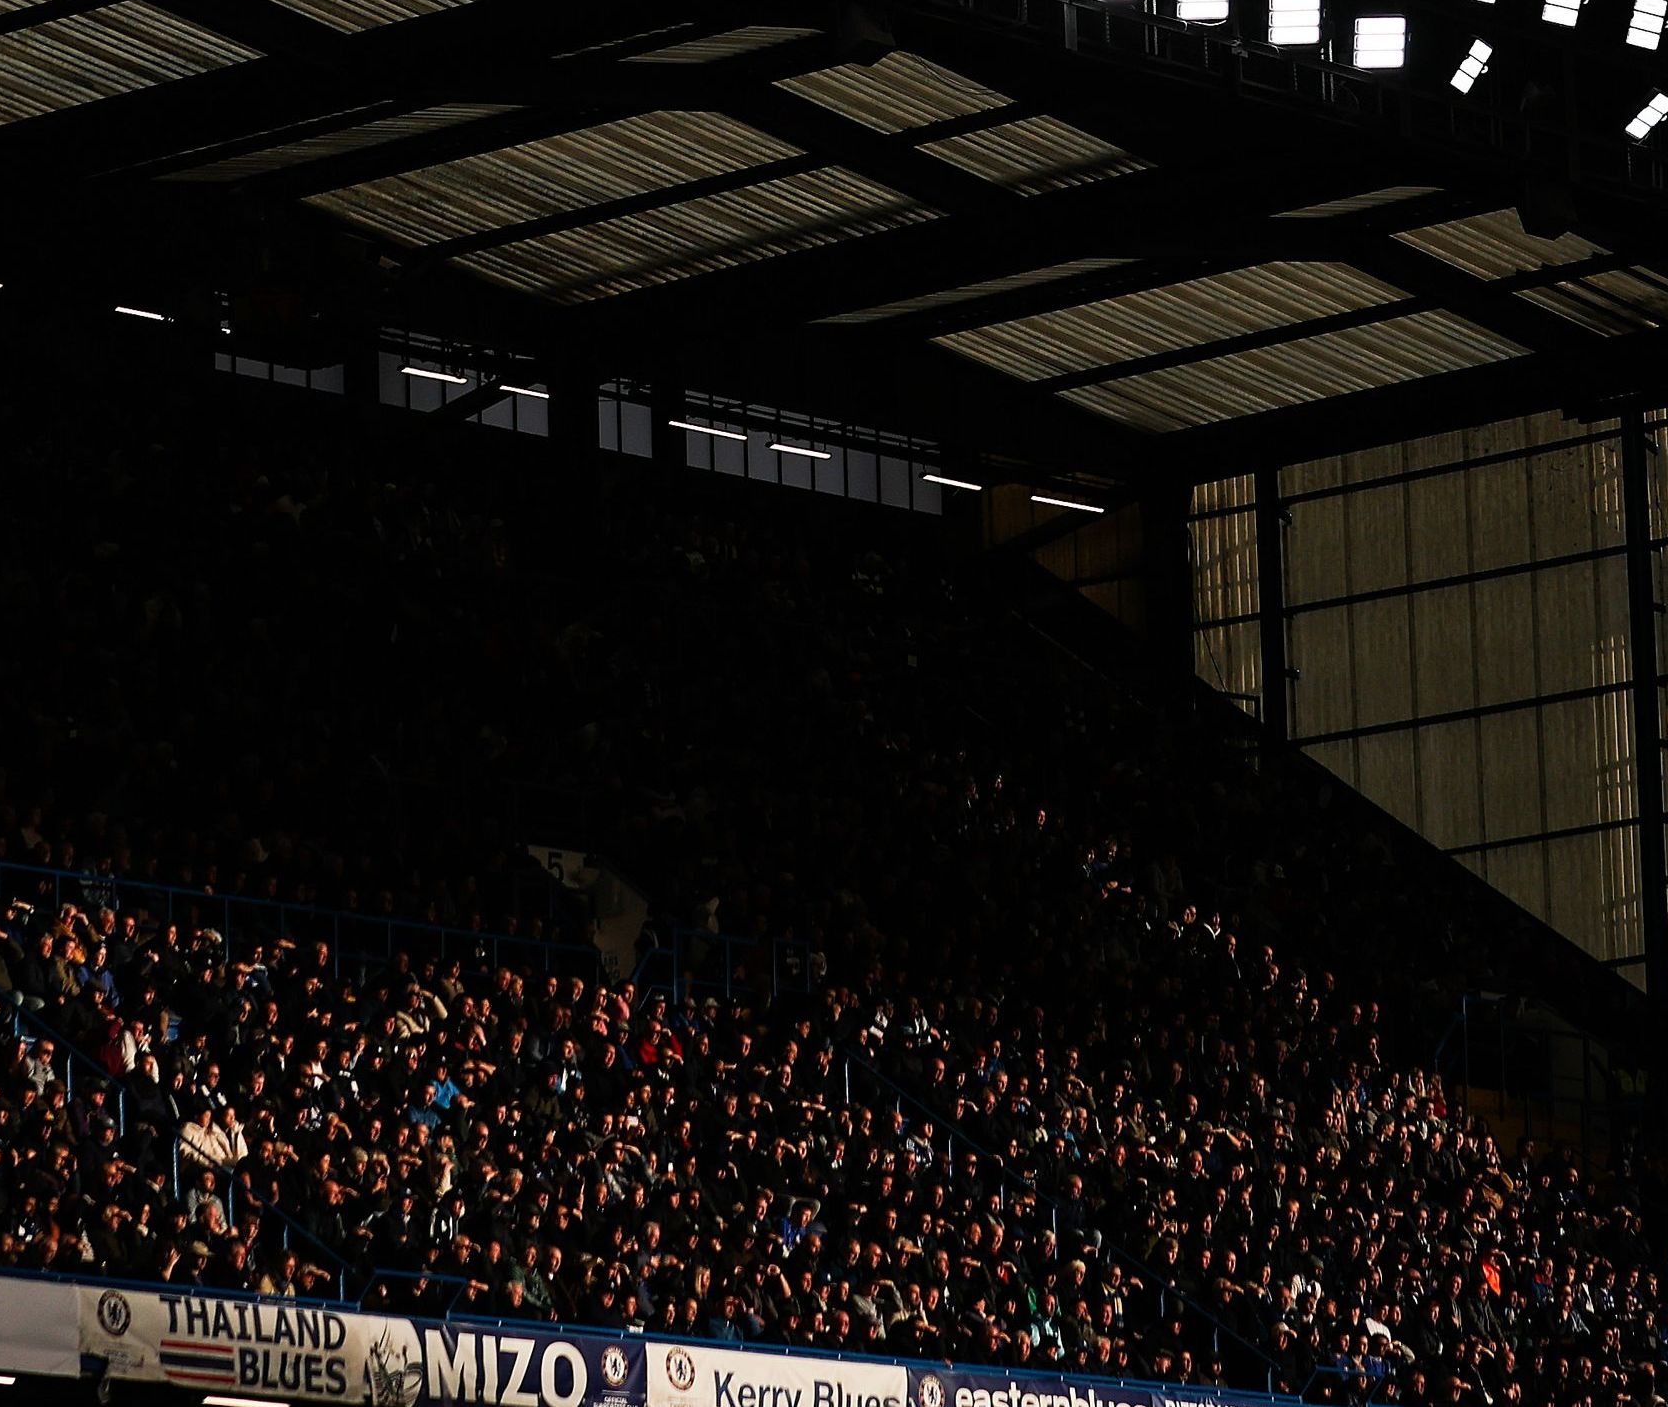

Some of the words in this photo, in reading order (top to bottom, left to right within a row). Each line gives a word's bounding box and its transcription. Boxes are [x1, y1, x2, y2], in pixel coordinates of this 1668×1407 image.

[159, 1294, 346, 1350] THAILAND
[239, 1348, 347, 1395] BLUES
[424, 1328, 588, 1407] MIZO
[954, 1381, 1149, 1407] easternbl
